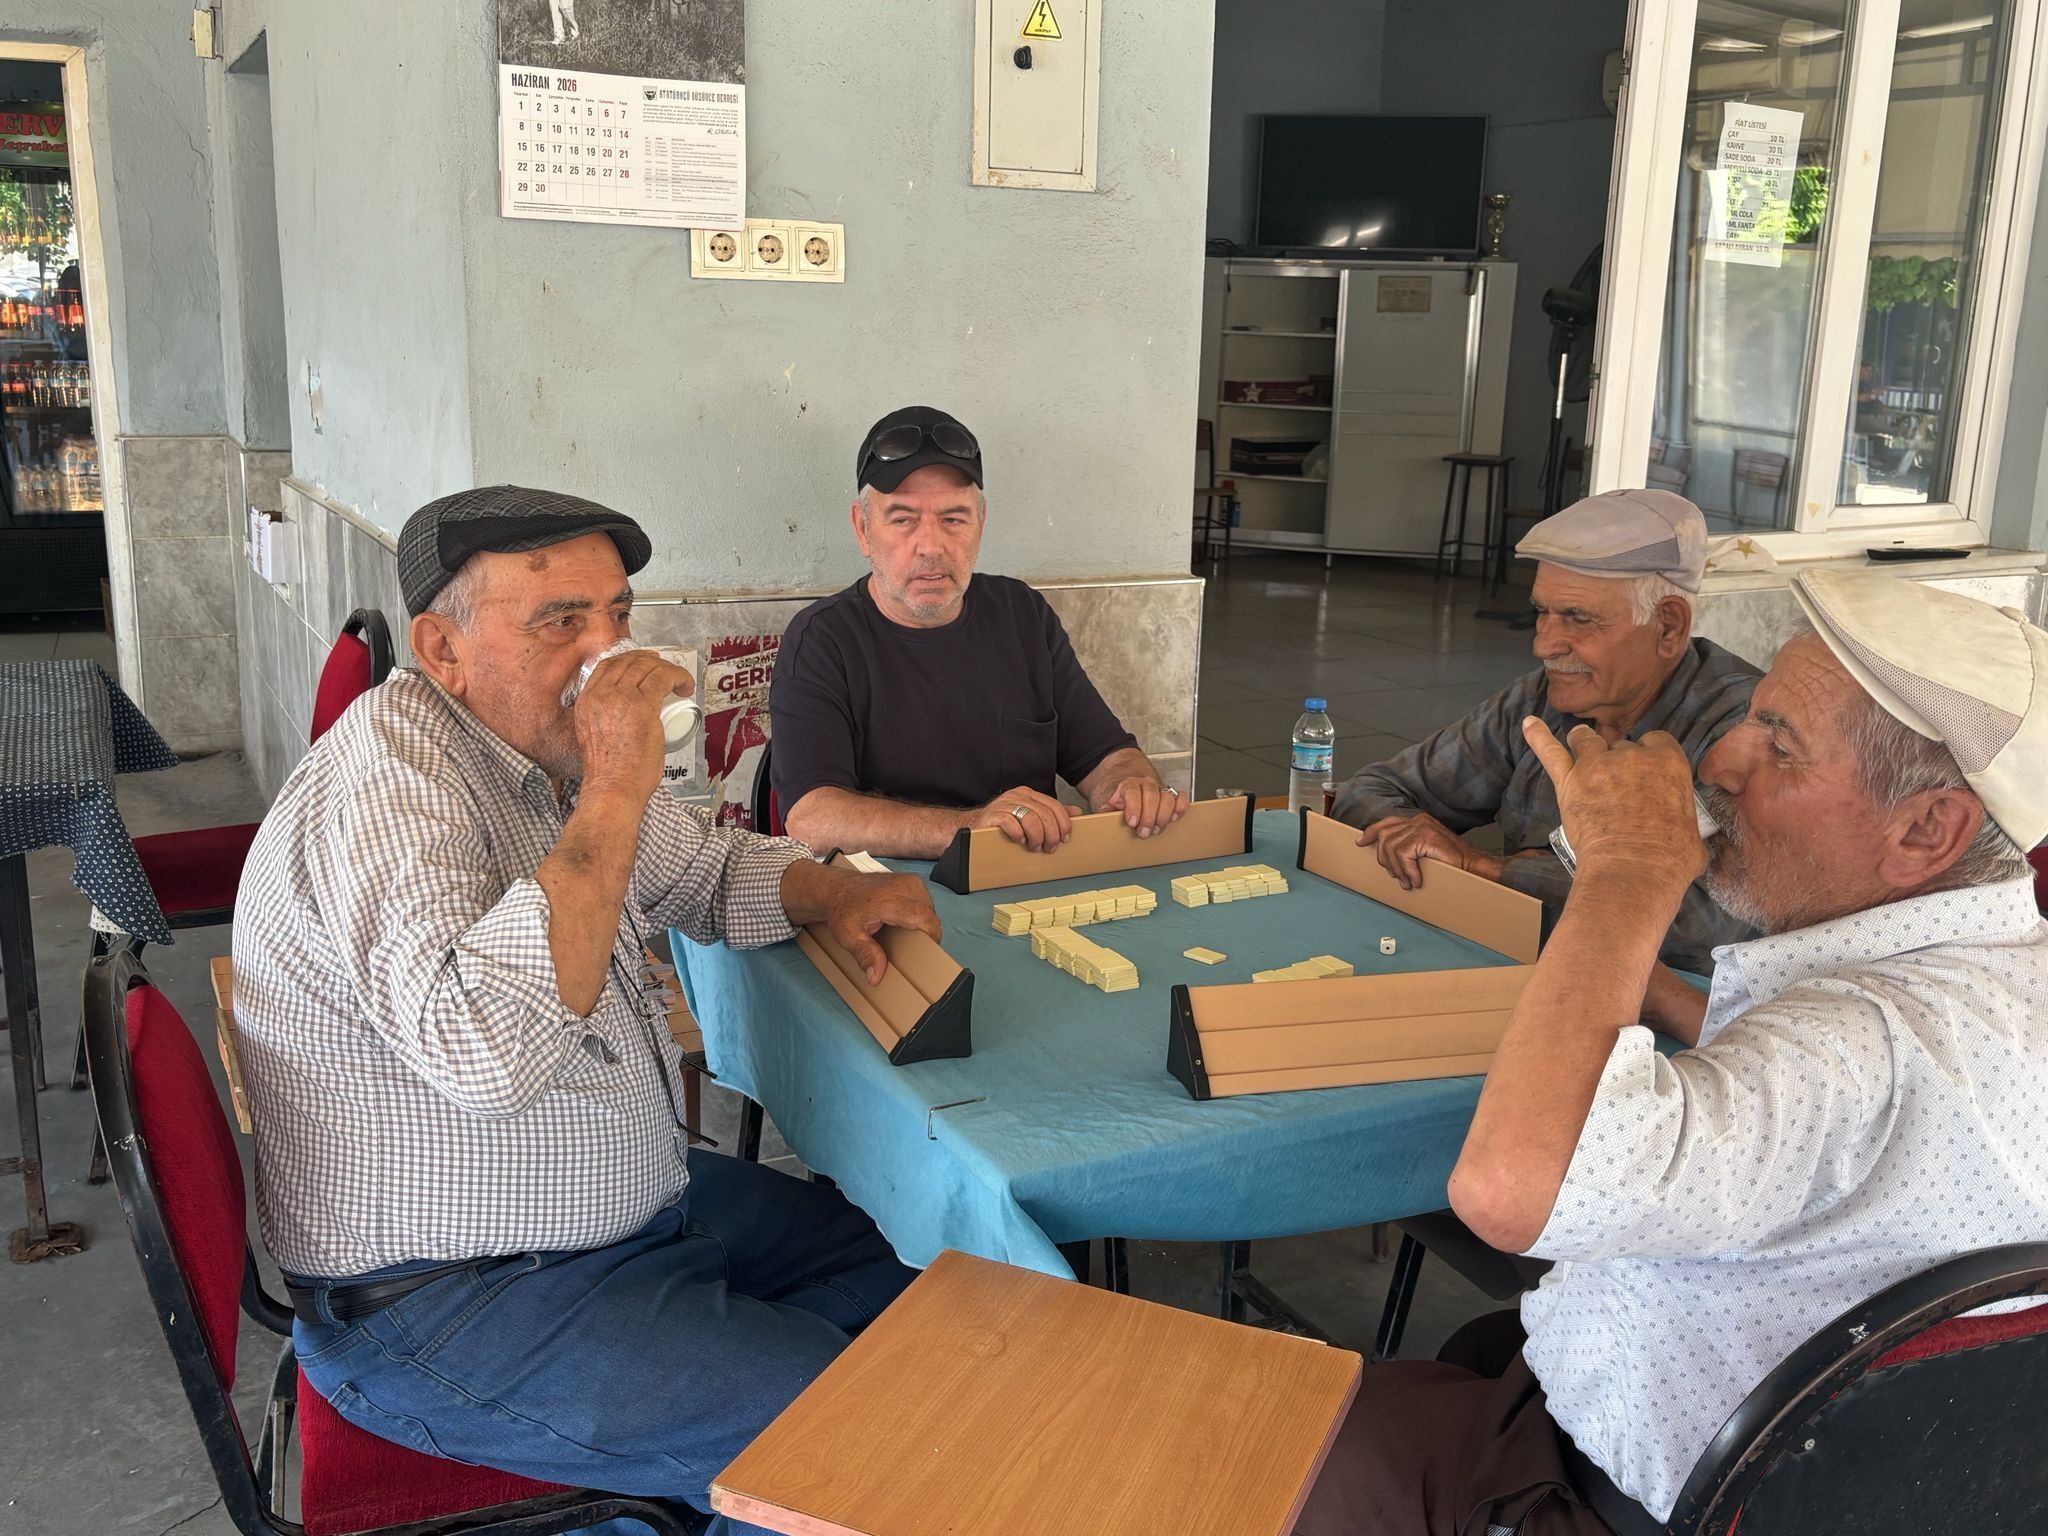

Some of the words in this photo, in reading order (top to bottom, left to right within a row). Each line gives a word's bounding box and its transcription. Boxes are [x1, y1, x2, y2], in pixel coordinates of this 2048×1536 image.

[511, 73, 550, 90] HAZİRAN
[557, 78, 577, 93] 2026
[519, 101, 522, 110] 1
[536, 103, 541, 111] 2
[553, 104, 559, 113] 3
[570, 106, 575, 114] 4
[587, 108, 592, 116] 5
[604, 109, 609, 117] 6
[620, 111, 626, 119] 7
[518, 122, 524, 130] 8
[536, 123, 542, 132] 9
[552, 125, 561, 133] 10
[569, 126, 577, 135] 11
[586, 128, 595, 136] 12
[603, 129, 612, 137] 13
[620, 130, 628, 138] 14
[1748, 120, 1767, 130] LİSTESİ
[1727, 130, 1740, 139] ÇAY
[1770, 135, 1778, 143] 10
[1779, 135, 1785, 144] TL
[518, 142, 527, 151] 15
[536, 144, 545, 152] 16
[552, 145, 562, 153] 17
[570, 146, 579, 155] 18
[587, 148, 595, 156] 19
[603, 149, 612, 157] 20
[619, 150, 628, 158] 21
[1726, 141, 1745, 151] KAHVE
[1777, 146, 1783, 155] TL
[1725, 152, 1740, 161] SADE
[1740, 154, 1756, 163] SODA
[1775, 158, 1782, 166] TL
[518, 162, 528, 171] 22
[536, 164, 545, 172] 23
[553, 165, 562, 173] 24
[570, 166, 579, 175] 25
[587, 167, 596, 176] 26
[603, 169, 612, 177] 27
[620, 170, 629, 178] 28
[518, 183, 528, 191] 29
[536, 184, 545, 192] 30
